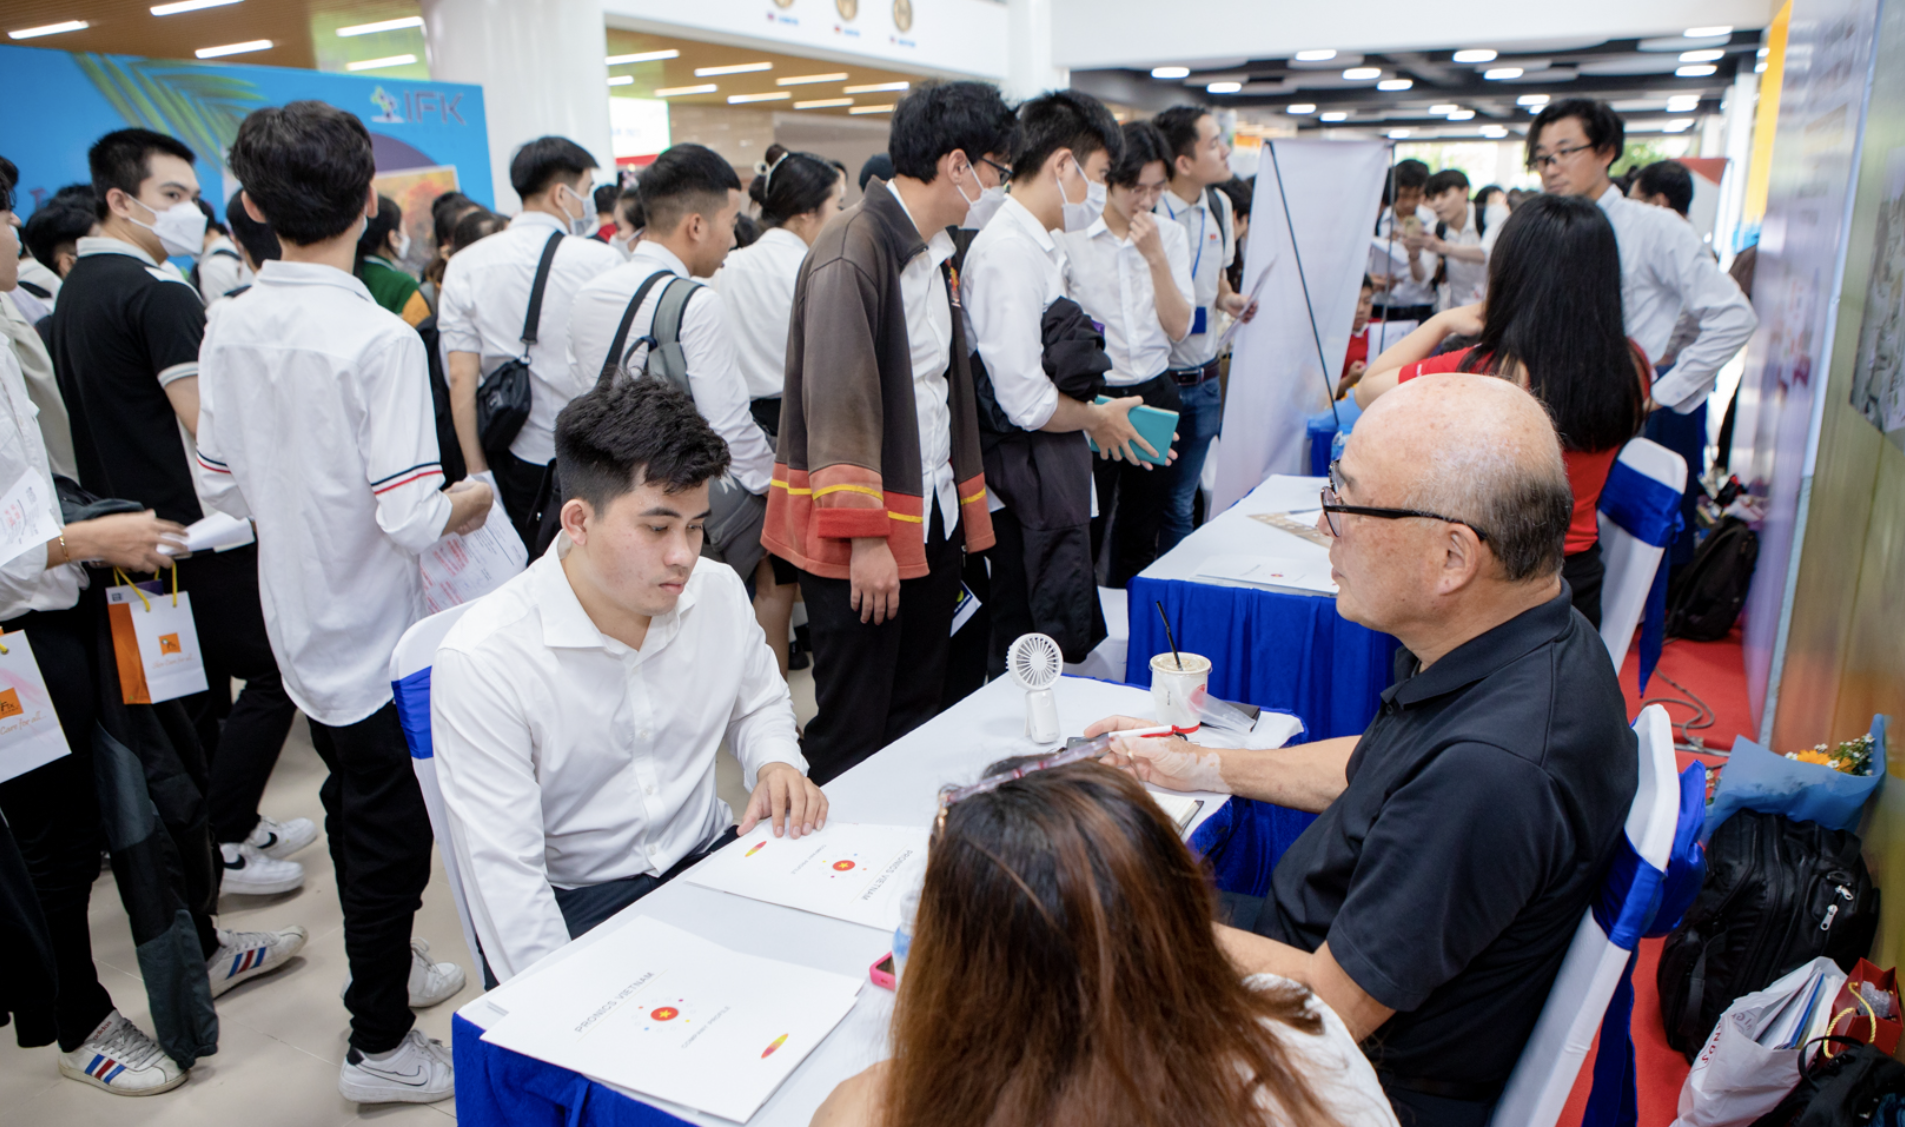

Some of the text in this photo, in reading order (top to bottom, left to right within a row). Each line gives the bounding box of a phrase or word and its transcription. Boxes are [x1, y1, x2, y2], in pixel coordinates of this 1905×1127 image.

[403, 90, 466, 125] IFK
[861, 849, 914, 901] PRONICS VIETNAM
[574, 971, 655, 1033] PRONICS VIETNAM
